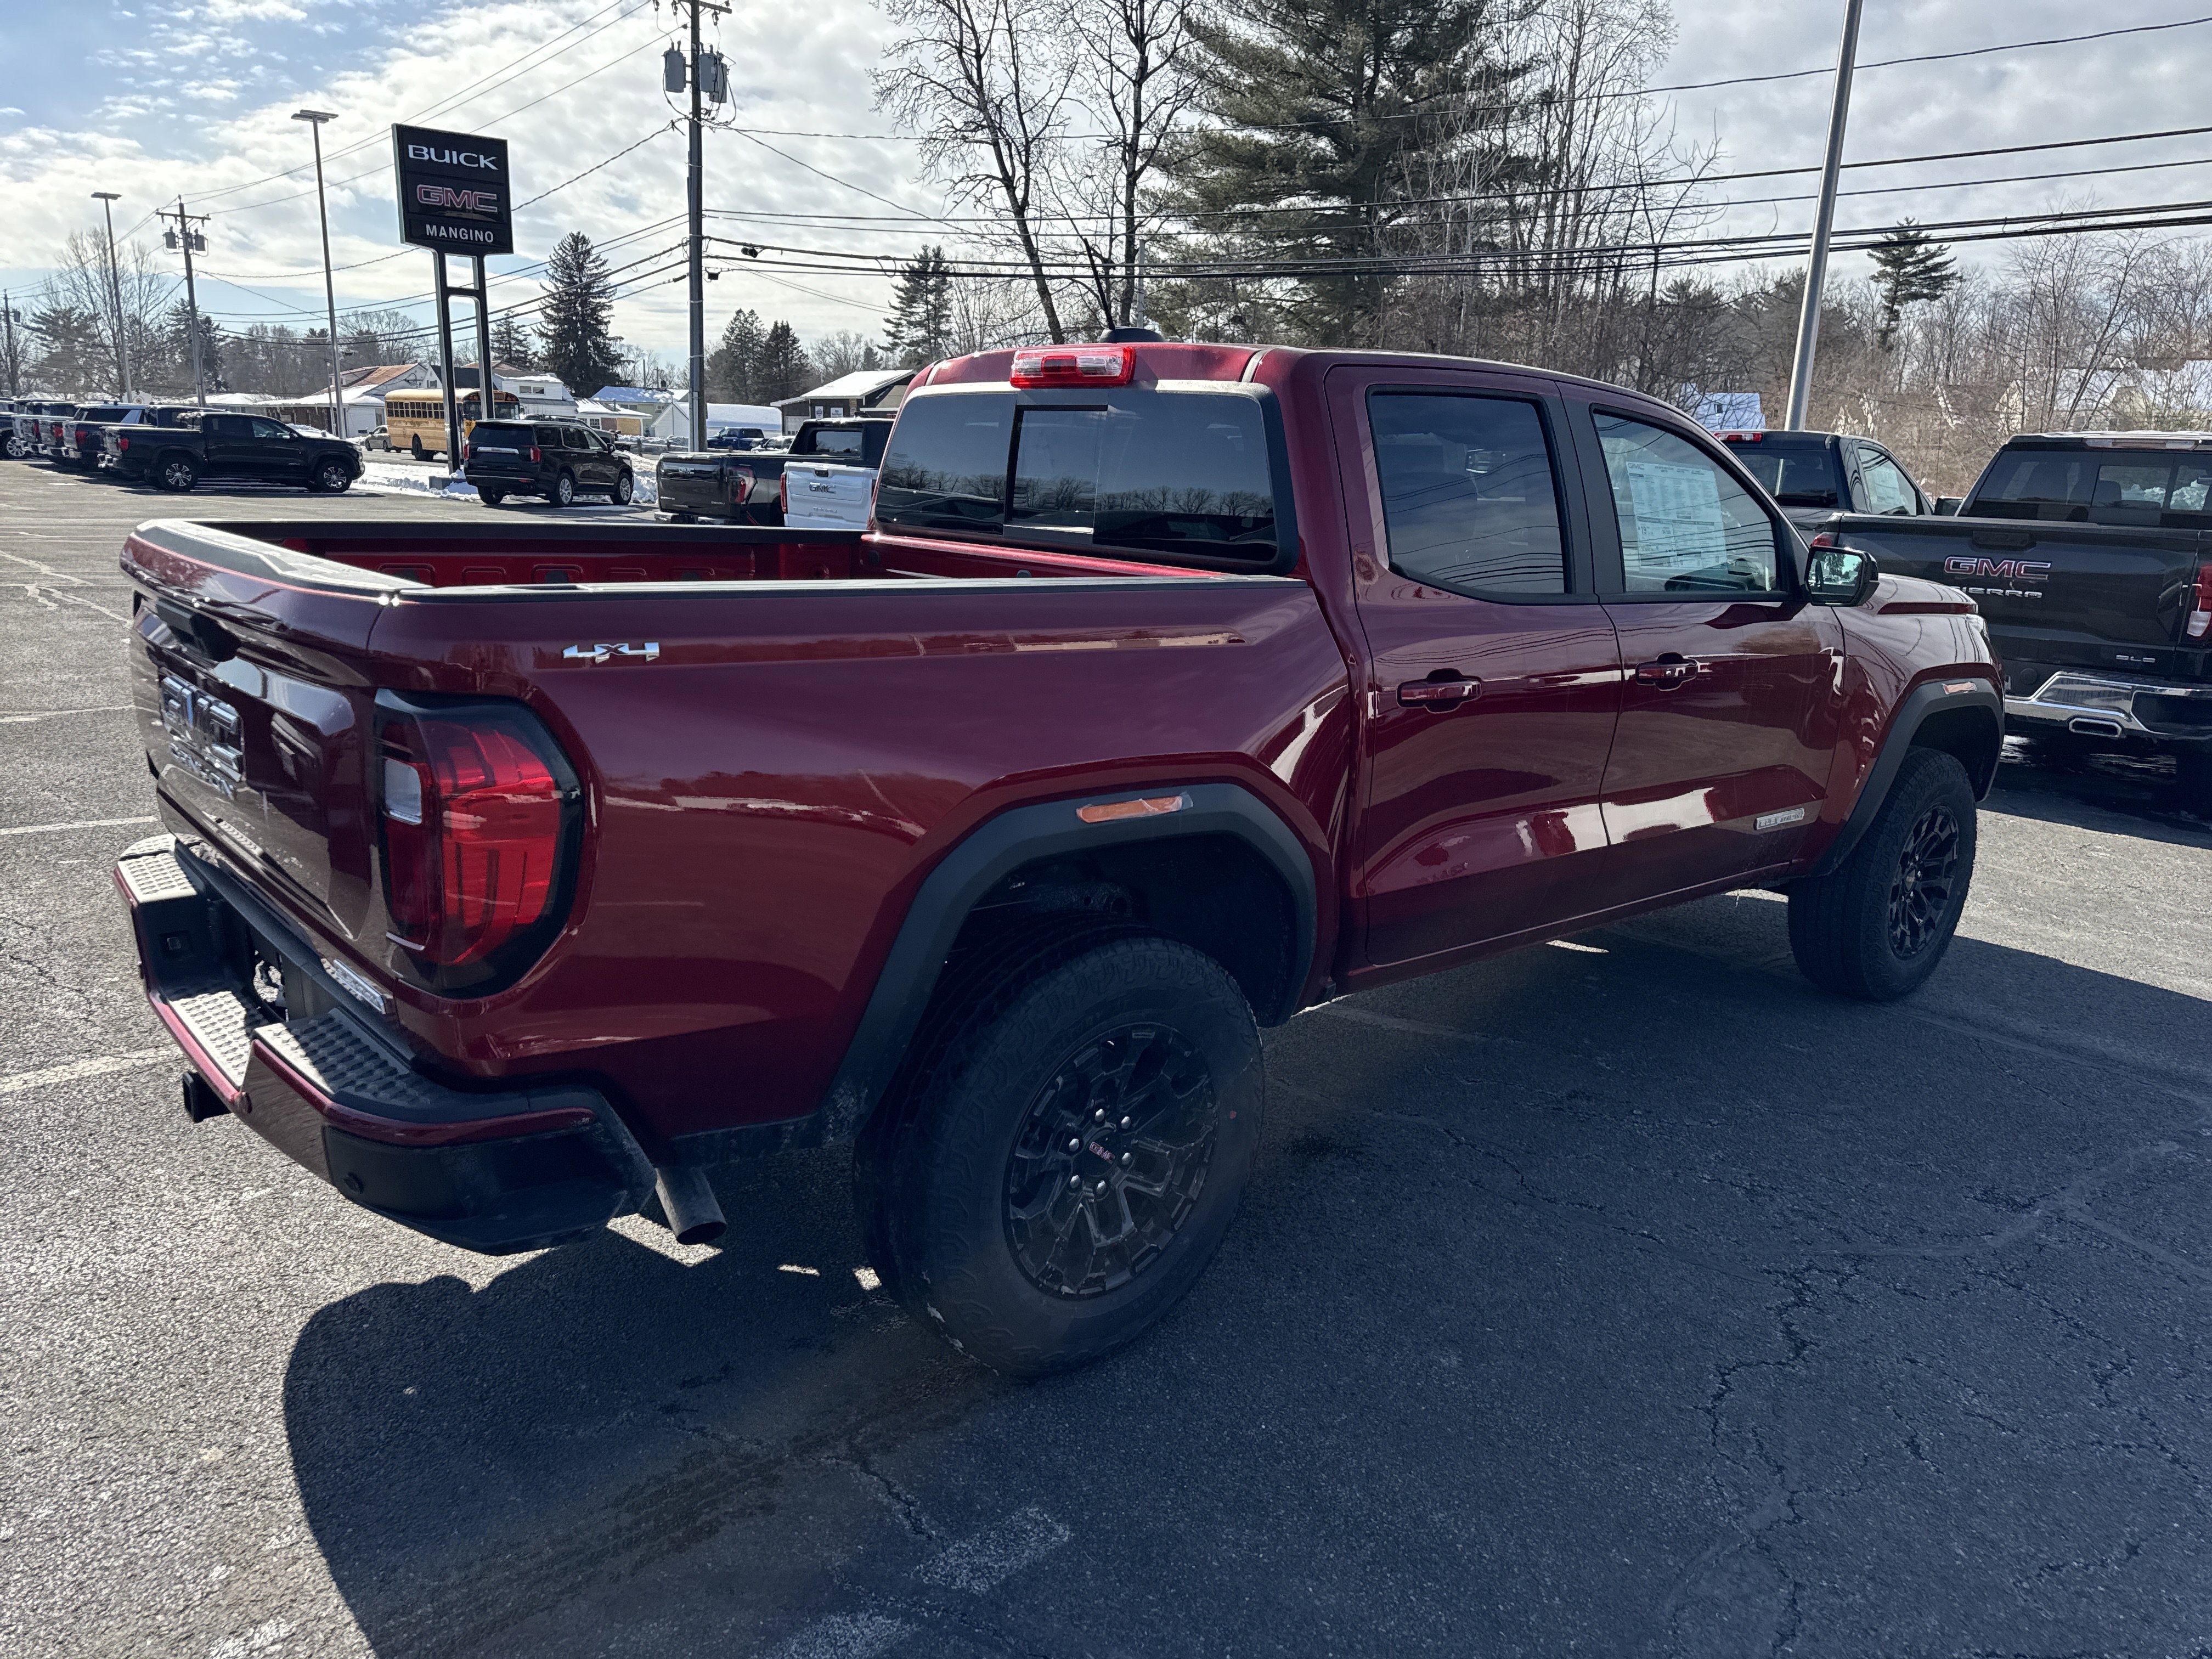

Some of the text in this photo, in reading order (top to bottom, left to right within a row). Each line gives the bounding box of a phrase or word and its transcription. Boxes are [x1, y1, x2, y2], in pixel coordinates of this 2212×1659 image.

[408, 144, 499, 170] BUICK
[417, 184, 498, 212] GMC
[426, 224, 494, 242] MANGINO
[809, 482, 836, 494] GMC
[1944, 556, 2051, 580] GMC
[1089, 1142, 1116, 1164] GMC
